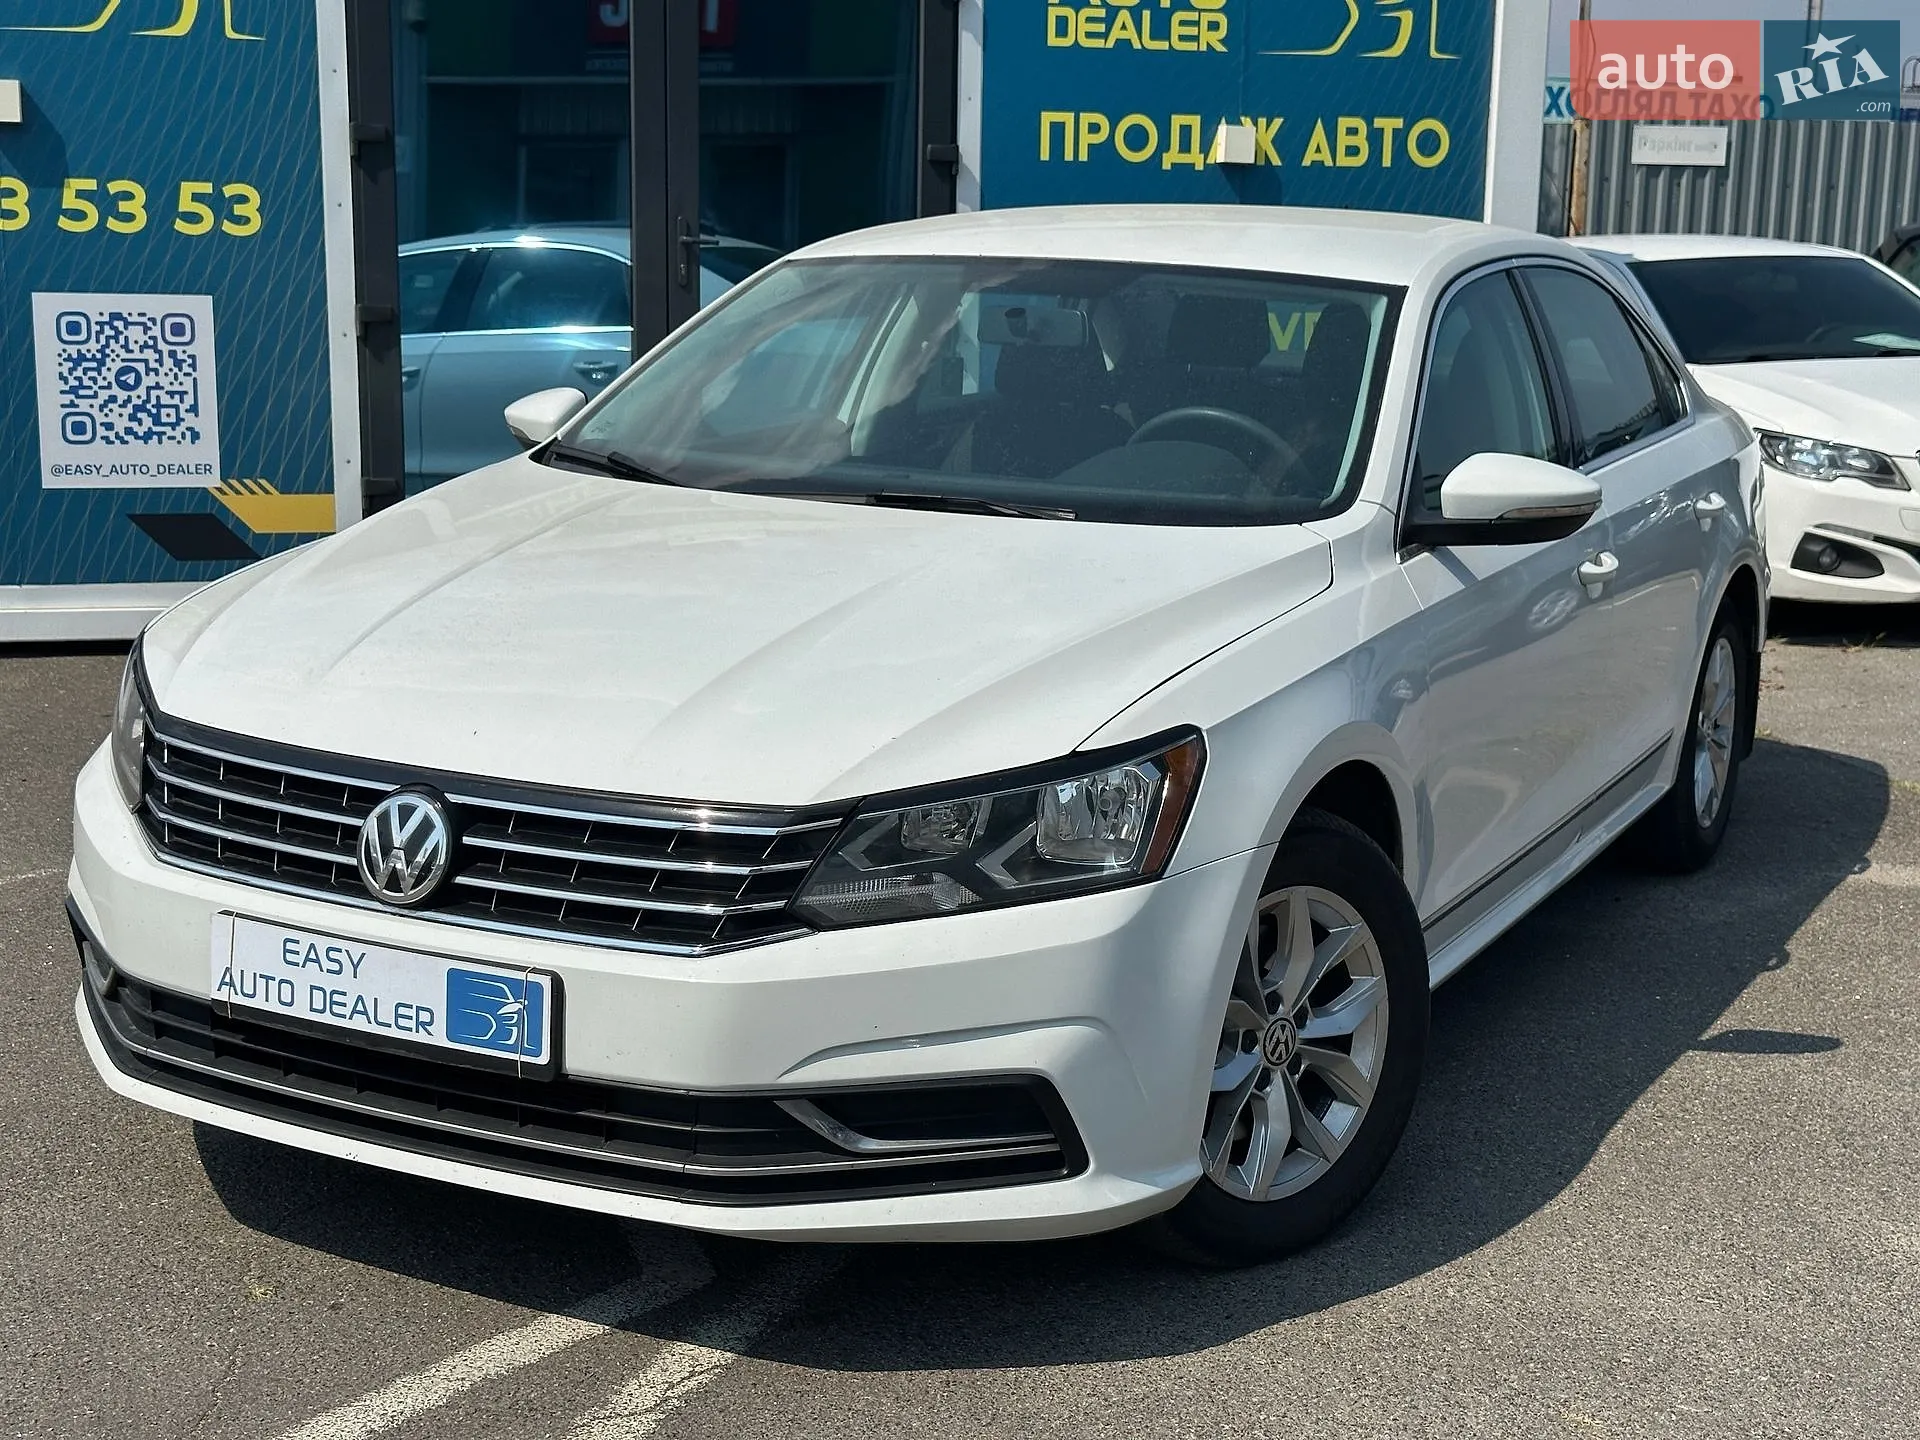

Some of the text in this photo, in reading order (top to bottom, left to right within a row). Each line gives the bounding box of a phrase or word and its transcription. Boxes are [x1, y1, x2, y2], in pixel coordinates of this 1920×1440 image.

[1047, 6, 1228, 52] DEALER
[1302, 116, 1450, 168] АВТО
[57, 178, 147, 233] 53
[174, 181, 262, 237] 53
[50, 463, 213, 477] @EASY_AUTO_DEALER
[282, 937, 366, 979] EASY
[216, 966, 435, 1037] AUTO DEALER
